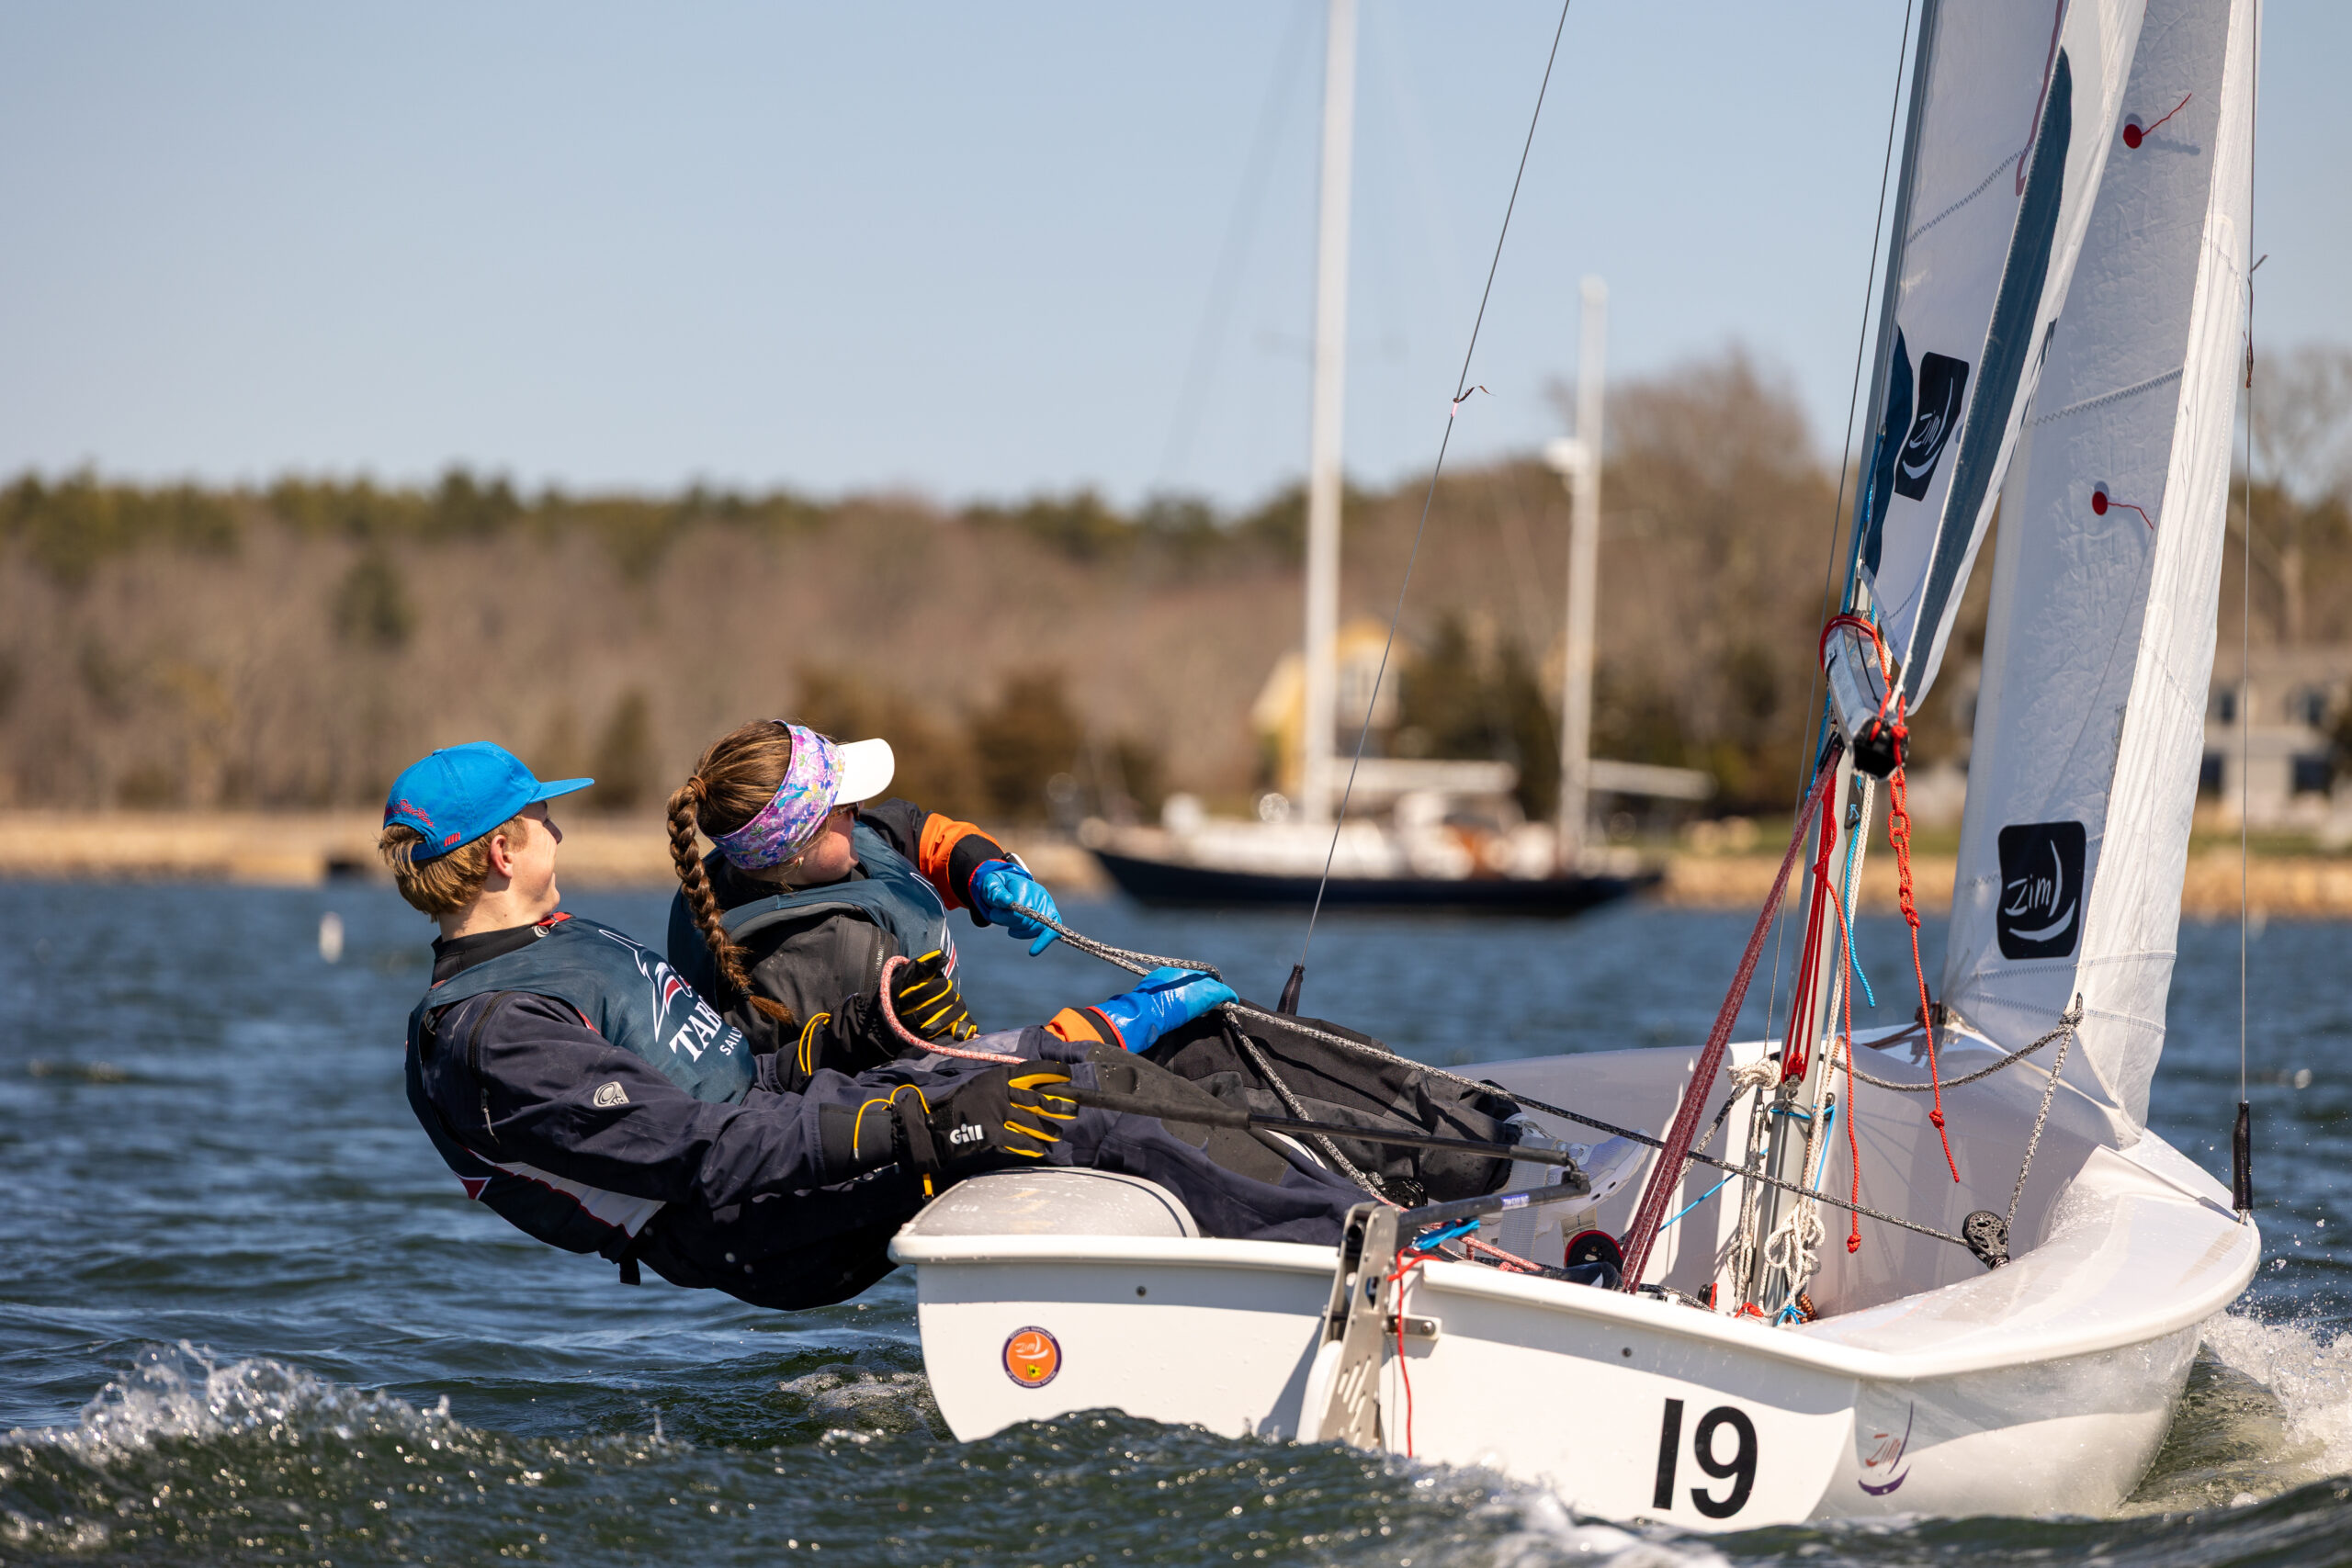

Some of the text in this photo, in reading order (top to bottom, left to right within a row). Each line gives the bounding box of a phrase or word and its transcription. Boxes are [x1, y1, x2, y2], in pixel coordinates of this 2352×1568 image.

[669, 995, 722, 1063] TAB
[949, 1123, 984, 1145] Gill
[1652, 1397, 1758, 1519] 19
